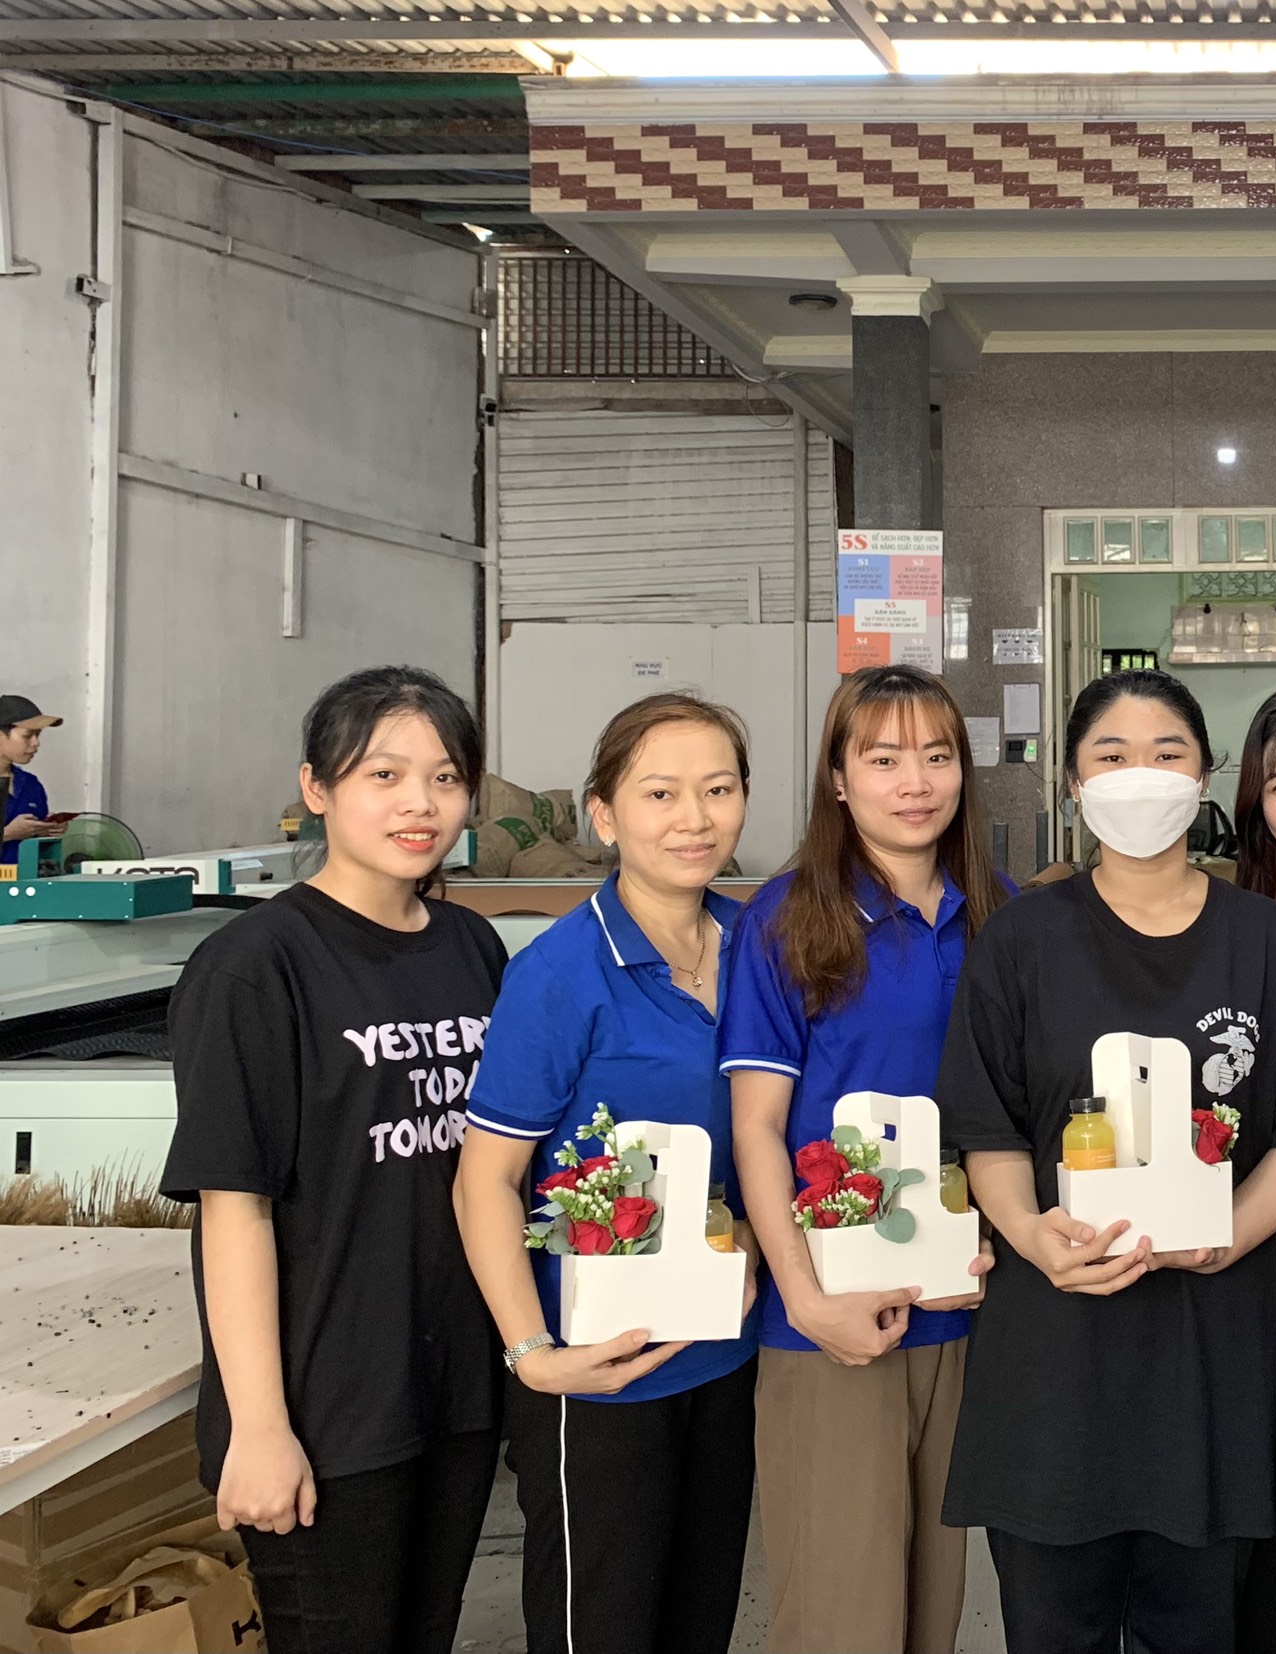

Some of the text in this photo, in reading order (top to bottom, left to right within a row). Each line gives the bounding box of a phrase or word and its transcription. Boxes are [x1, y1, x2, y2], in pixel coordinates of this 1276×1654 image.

[841, 534, 868, 550] 5S
[1196, 1007, 1234, 1032] DEVIL
[343, 1016, 491, 1067] YESTER
